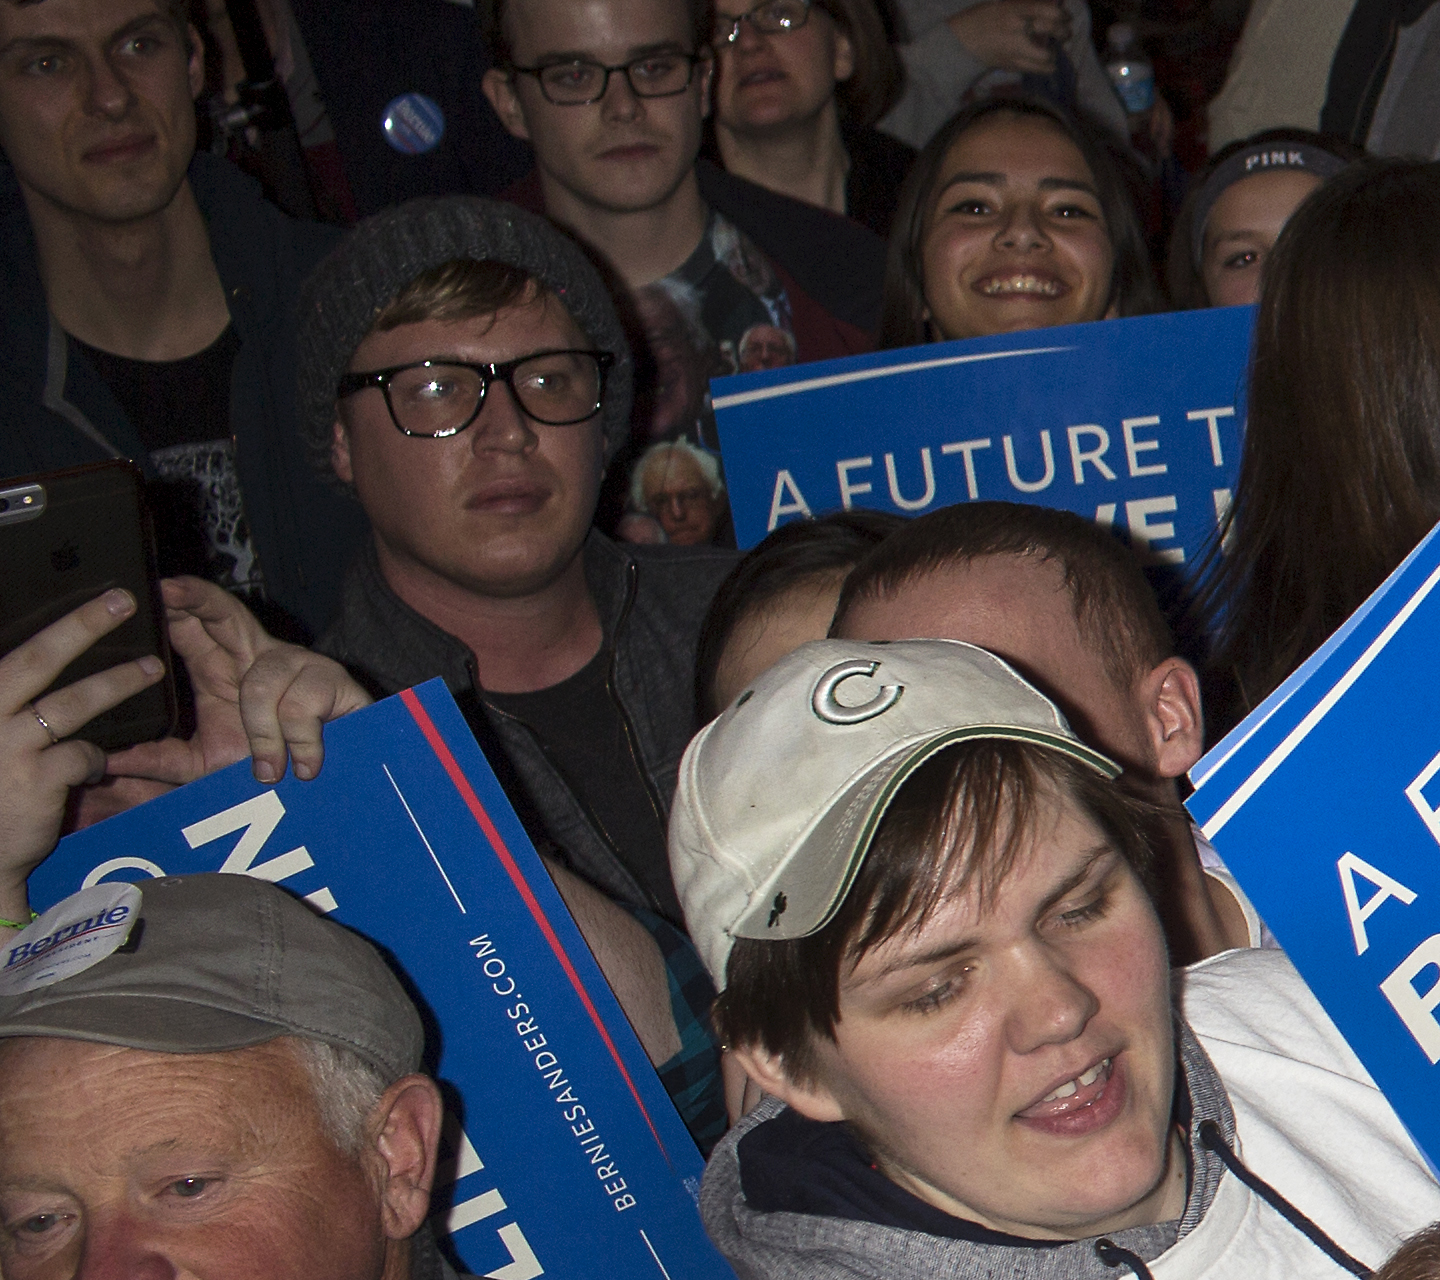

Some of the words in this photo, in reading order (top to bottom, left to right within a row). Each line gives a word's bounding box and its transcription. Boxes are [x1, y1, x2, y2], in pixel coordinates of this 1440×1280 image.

[1245, 150, 1305, 171] PINK
[767, 470, 816, 532] A
[836, 415, 1169, 512] FUTURE
[1187, 406, 1235, 467] T
[811, 659, 905, 726] C
[3, 905, 130, 969] Bernie
[1336, 851, 1418, 957] A
[468, 932, 637, 1212] BERNIESANDERS.COM
